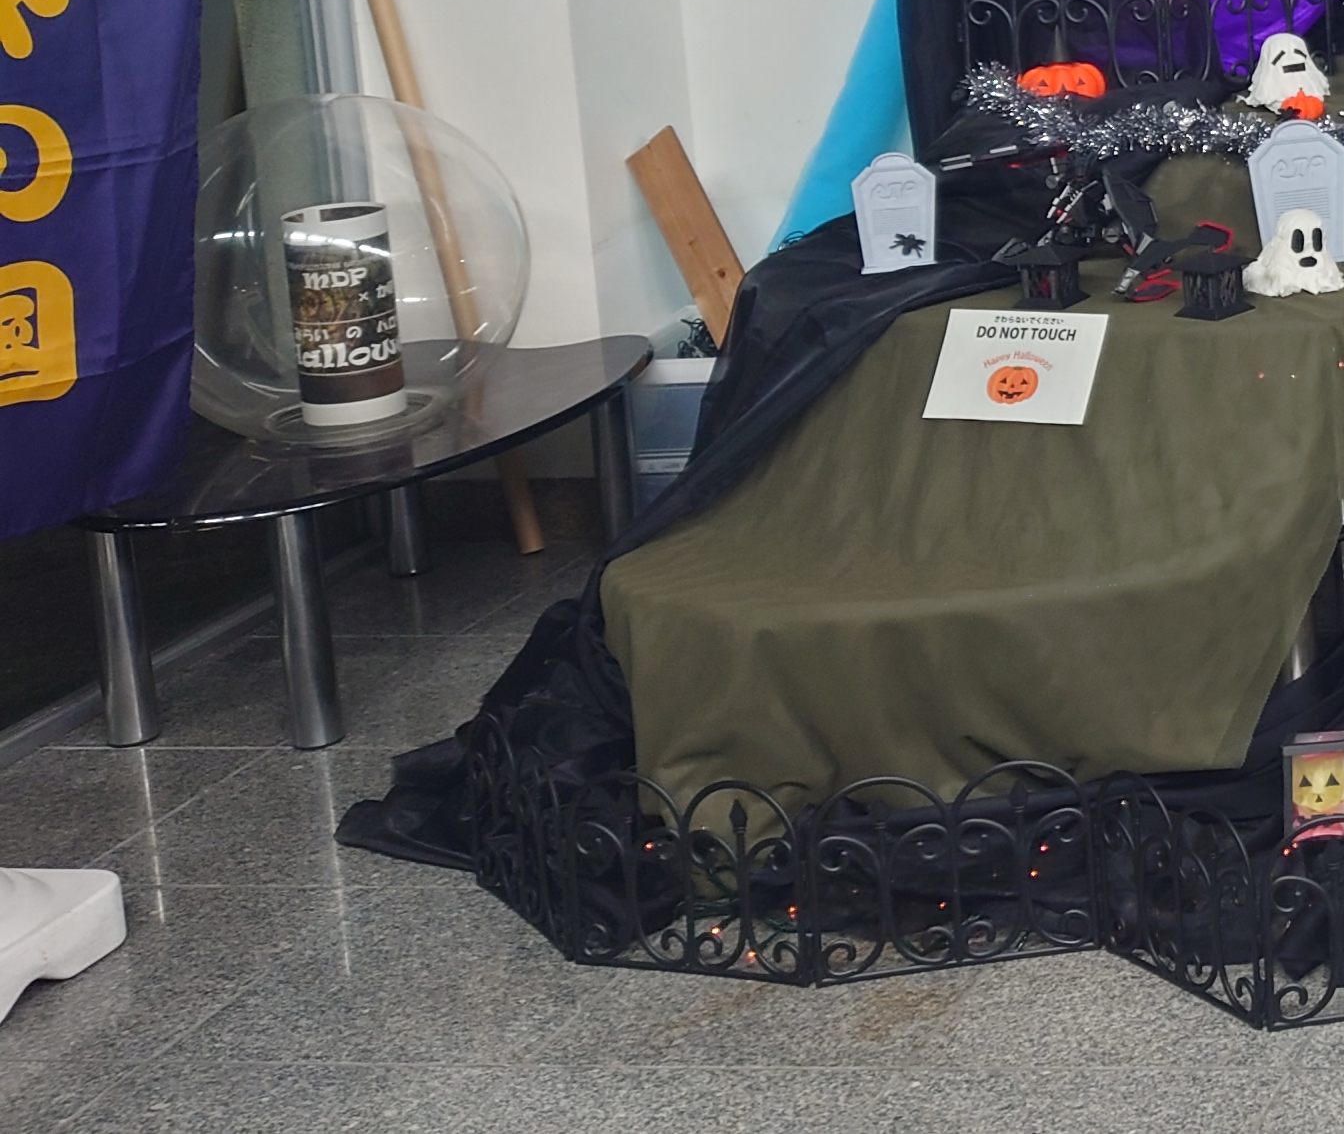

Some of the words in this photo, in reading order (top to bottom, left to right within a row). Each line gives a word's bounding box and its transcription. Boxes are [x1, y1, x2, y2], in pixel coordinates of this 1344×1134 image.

[993, 315, 1064, 324] さわらないでください
[976, 326, 996, 338] DO
[999, 327, 1028, 339] NOT
[1030, 328, 1076, 341] TOUCH
[983, 352, 1011, 368] Happy
[1013, 350, 1053, 371] Halloween
